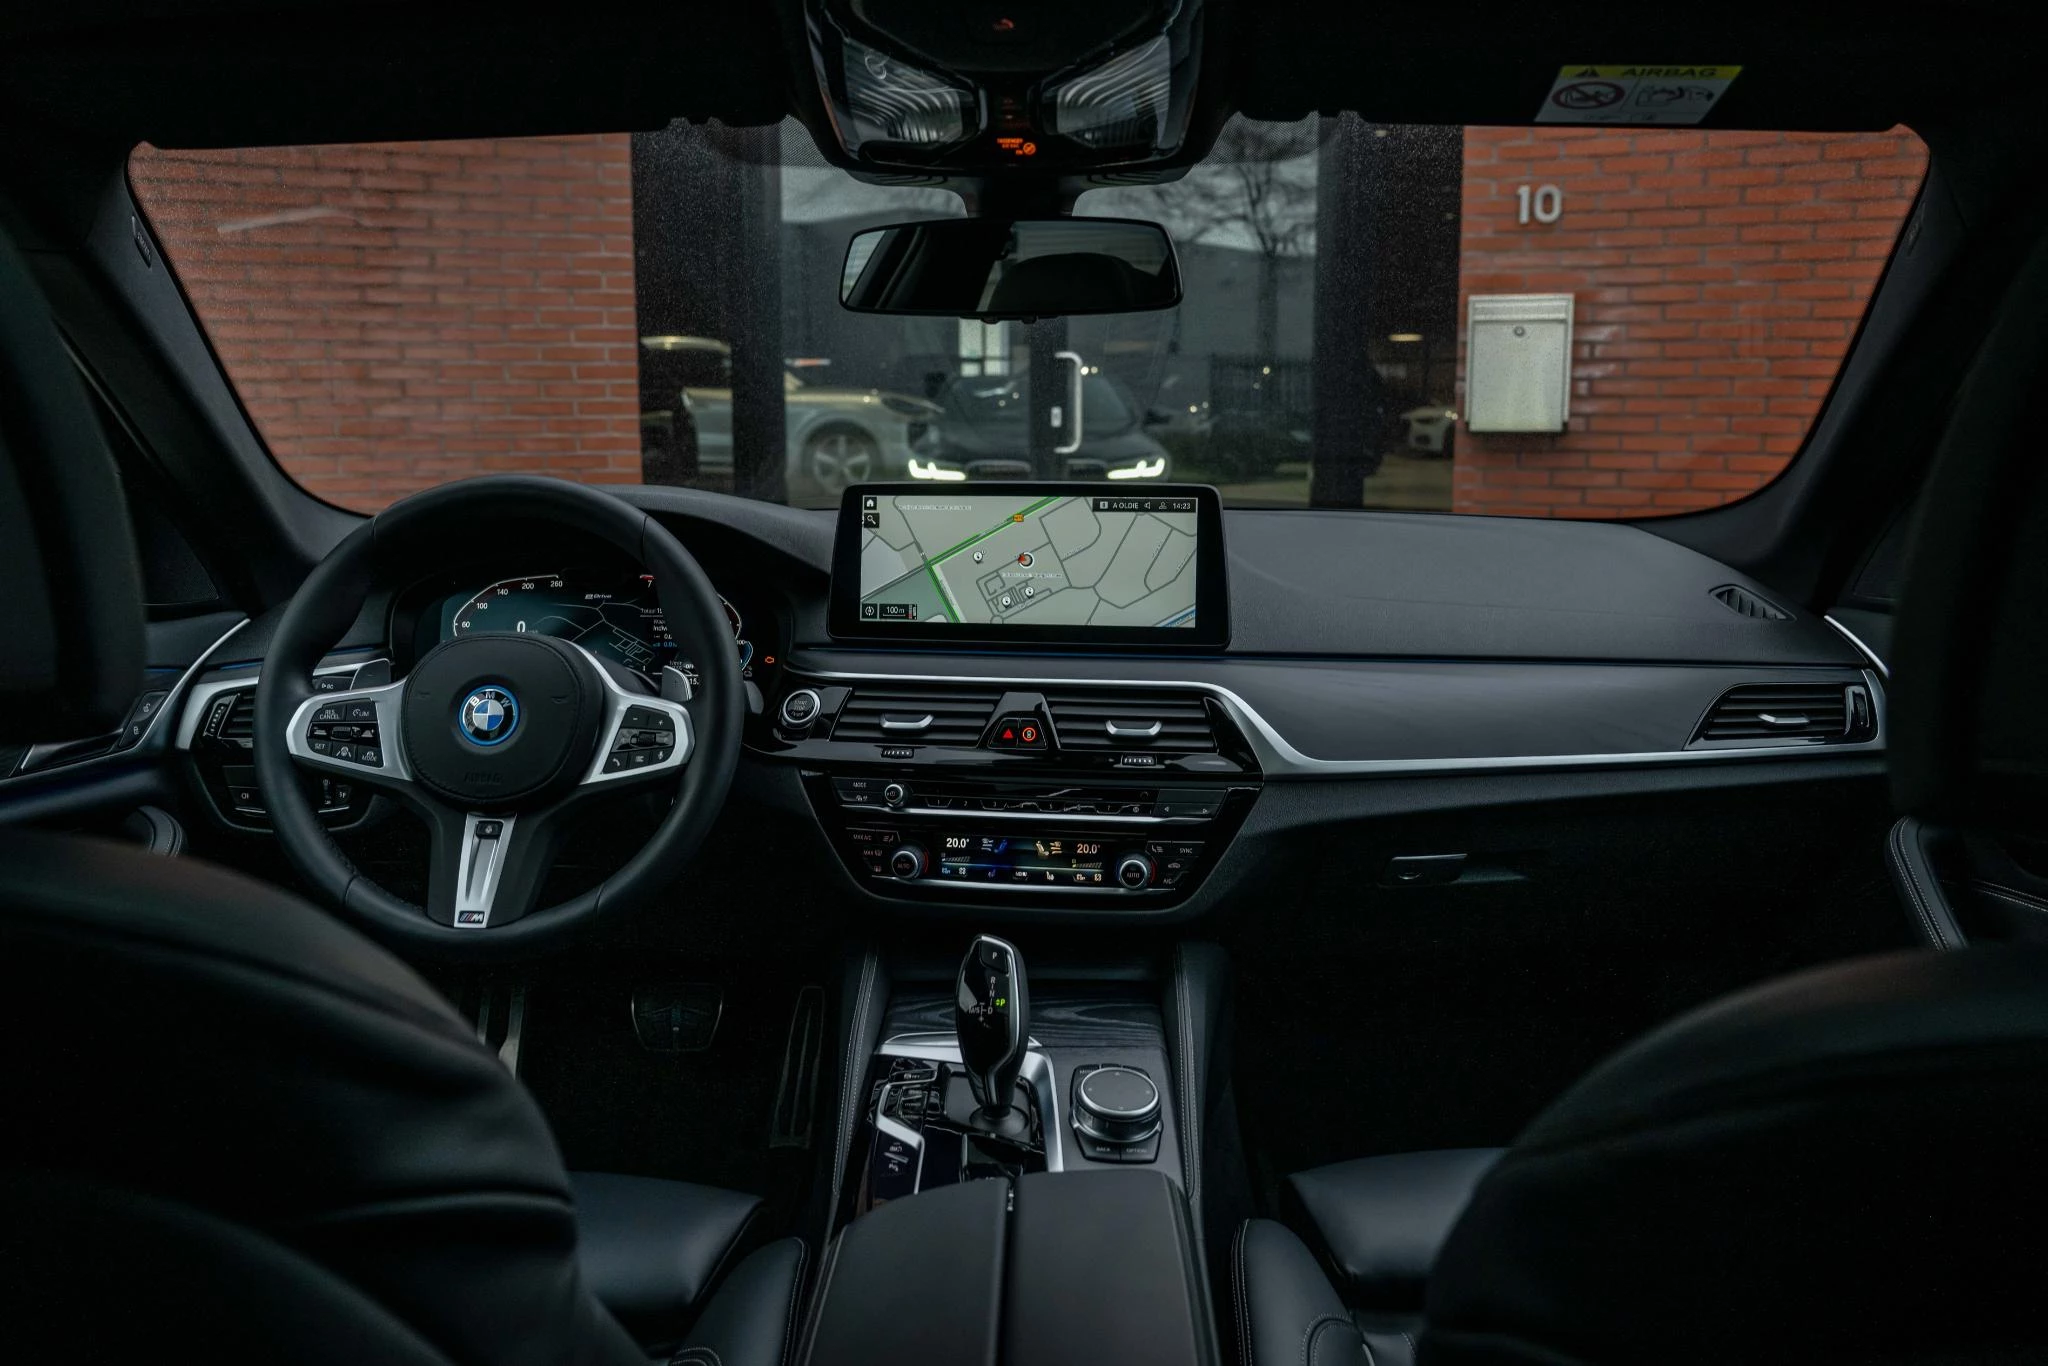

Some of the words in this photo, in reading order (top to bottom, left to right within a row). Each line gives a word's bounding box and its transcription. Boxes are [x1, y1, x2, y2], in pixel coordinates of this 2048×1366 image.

[1621, 67, 1717, 78] AIRBAG
[1516, 183, 1562, 225] 10
[1172, 502, 1191, 510] 14:23
[521, 582, 535, 590] 200
[550, 580, 563, 588] 260
[497, 588, 509, 596] 140
[476, 602, 488, 610] 100
[516, 620, 526, 633] 0
[469, 691, 512, 708] BMW
[992, 951, 998, 960] P
[990, 976, 996, 984] R
[989, 990, 995, 998] N
